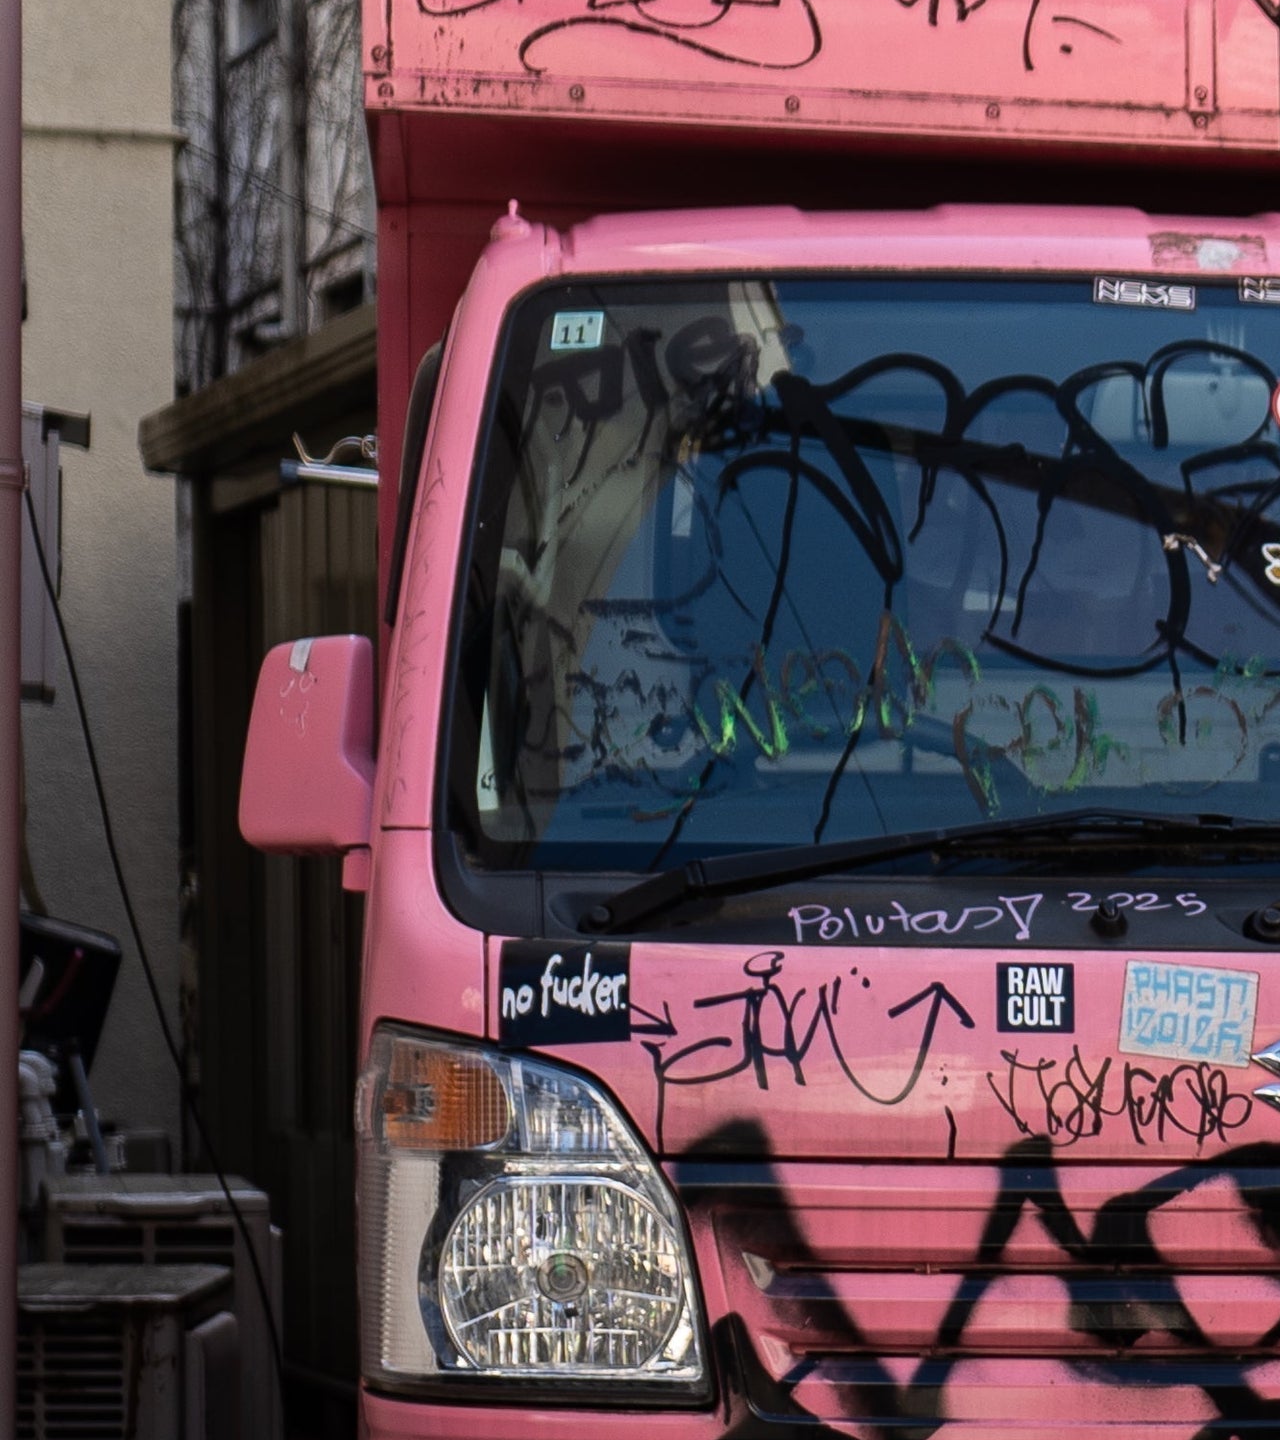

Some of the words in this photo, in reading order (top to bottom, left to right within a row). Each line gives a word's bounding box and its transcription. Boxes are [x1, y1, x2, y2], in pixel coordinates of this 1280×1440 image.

[560, 324, 585, 345] 11
[502, 983, 534, 1020] no
[540, 952, 627, 1018] fucker.
[1008, 966, 1065, 994] RAW
[1008, 995, 1067, 1026] CULT
